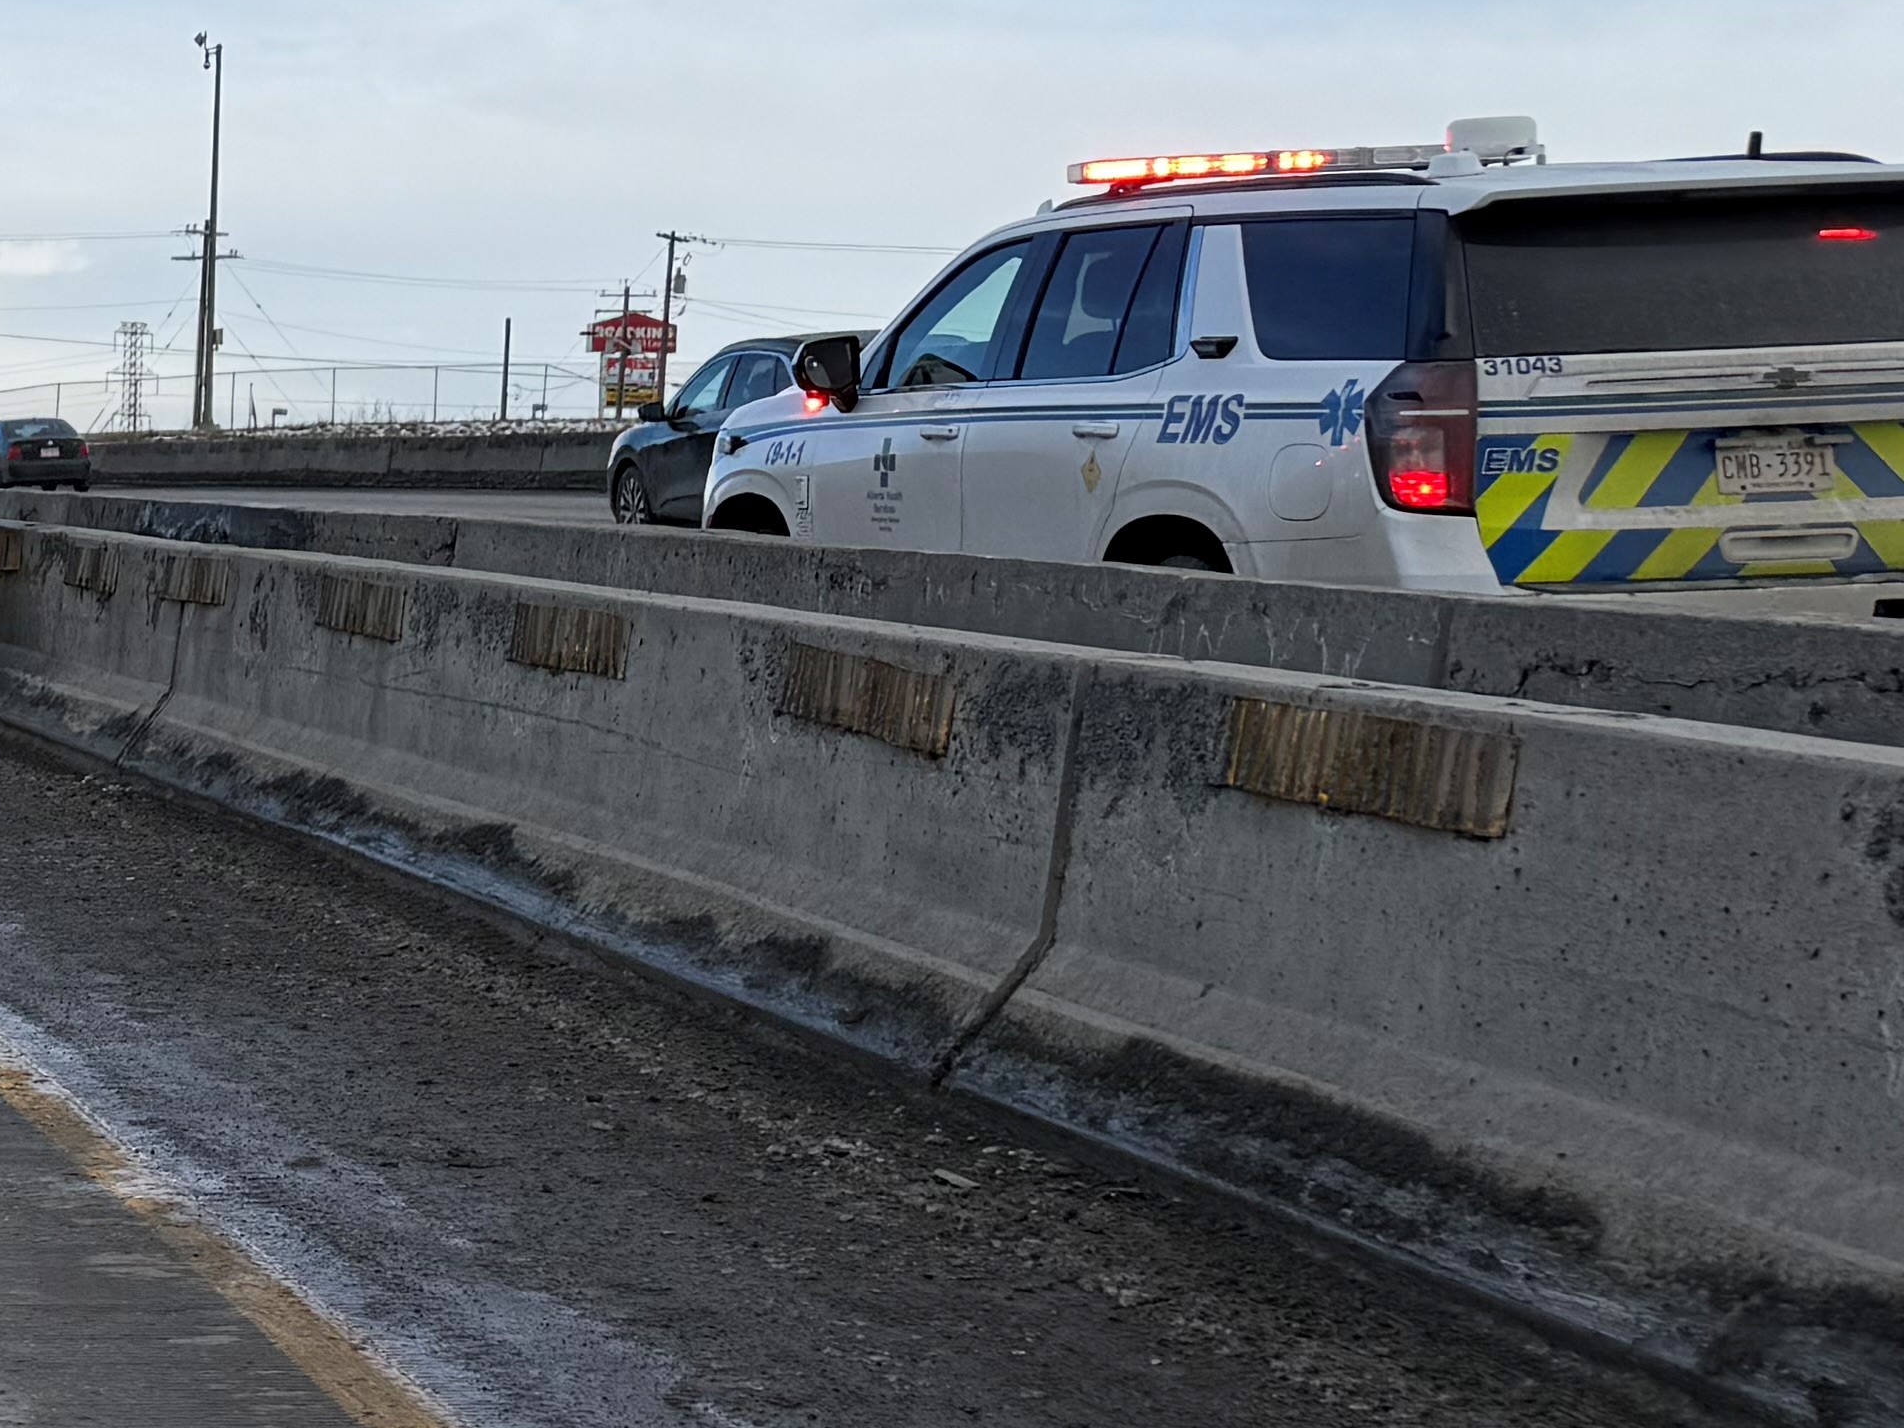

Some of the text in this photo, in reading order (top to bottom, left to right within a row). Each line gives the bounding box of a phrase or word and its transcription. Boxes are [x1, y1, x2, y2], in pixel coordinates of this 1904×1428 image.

[1483, 356, 1563, 376] 31043
[1156, 393, 1244, 445] EMS
[1481, 447, 1560, 474] EMS
